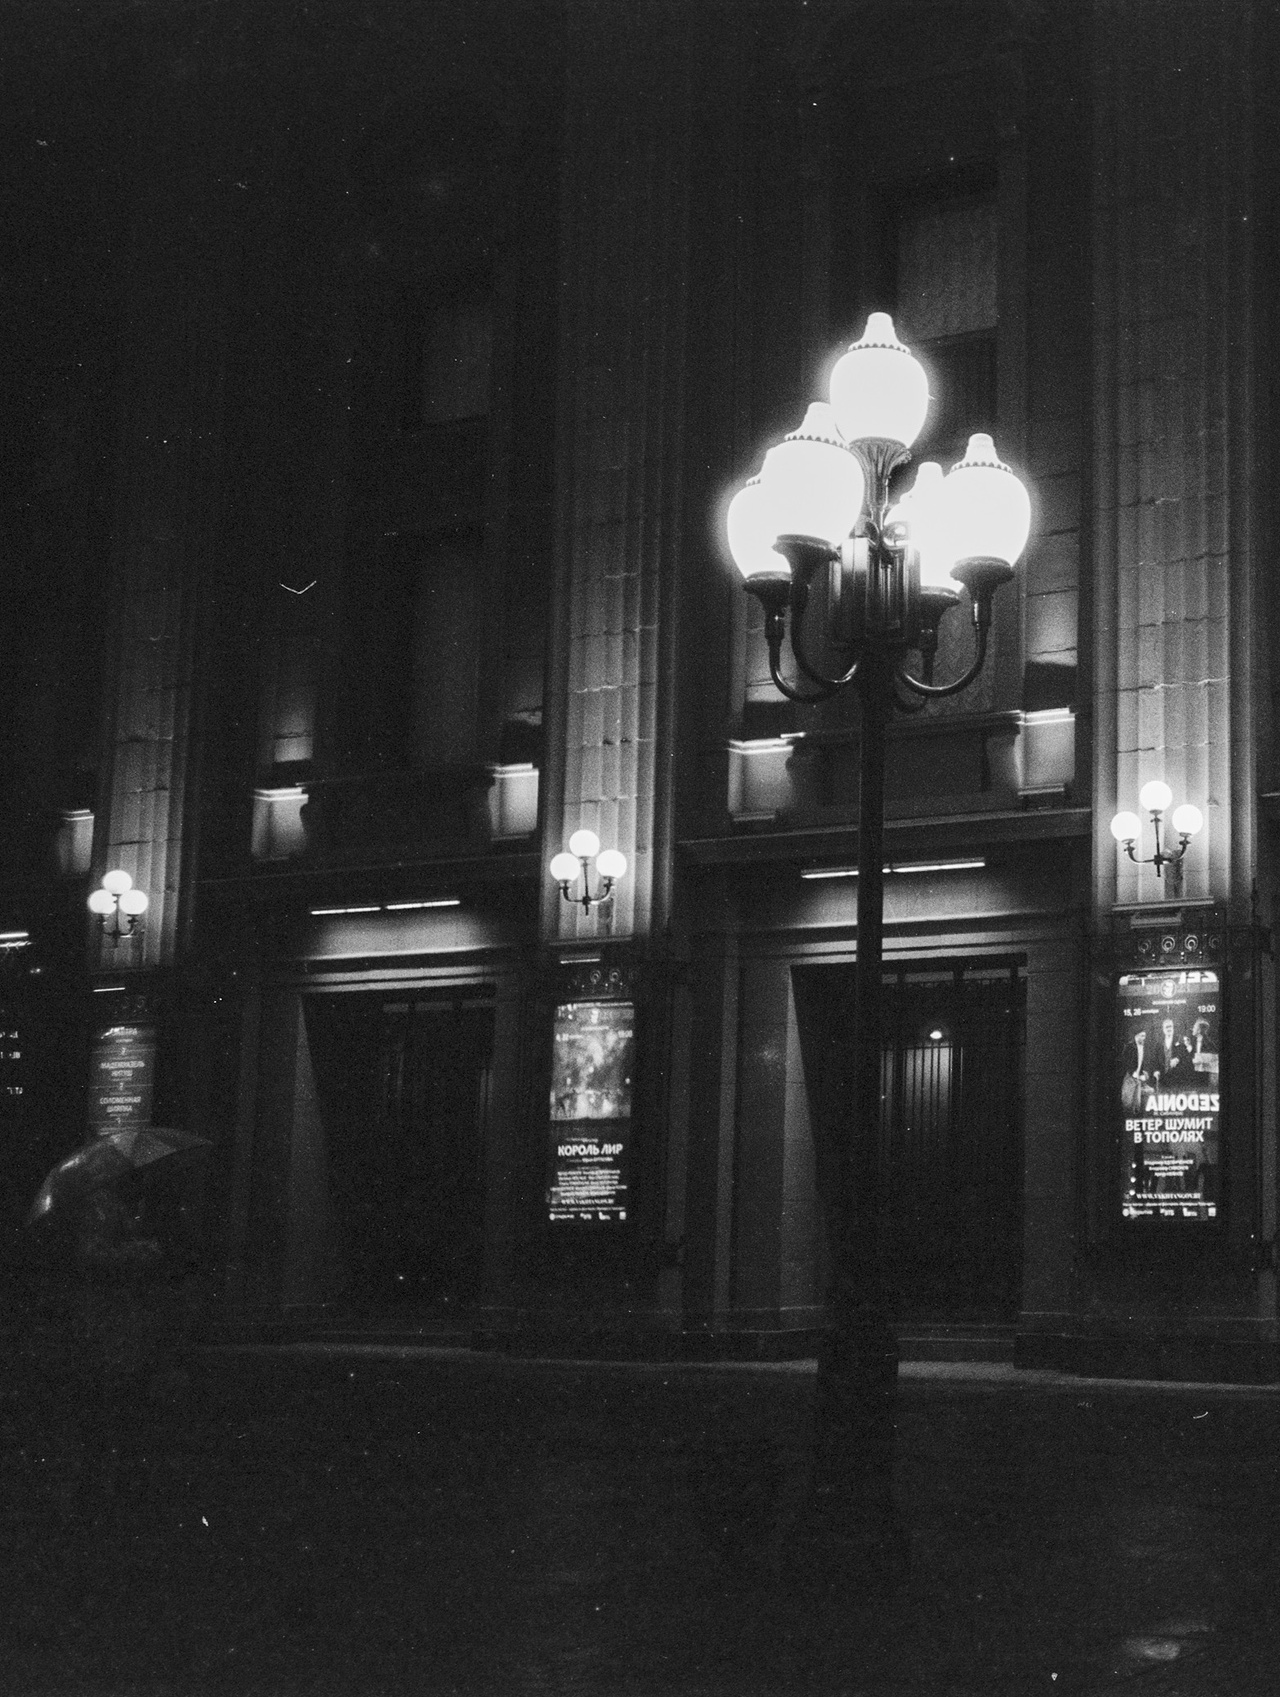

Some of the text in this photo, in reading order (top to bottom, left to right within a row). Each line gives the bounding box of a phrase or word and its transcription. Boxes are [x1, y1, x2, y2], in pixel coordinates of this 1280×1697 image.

[1125, 1117, 1214, 1132] ВЕТЕР ШУМИТ
[1133, 1130, 1205, 1144] В ТОПОЛЯХ
[557, 1142, 624, 1157] КОРОЛЬ ЛИР
